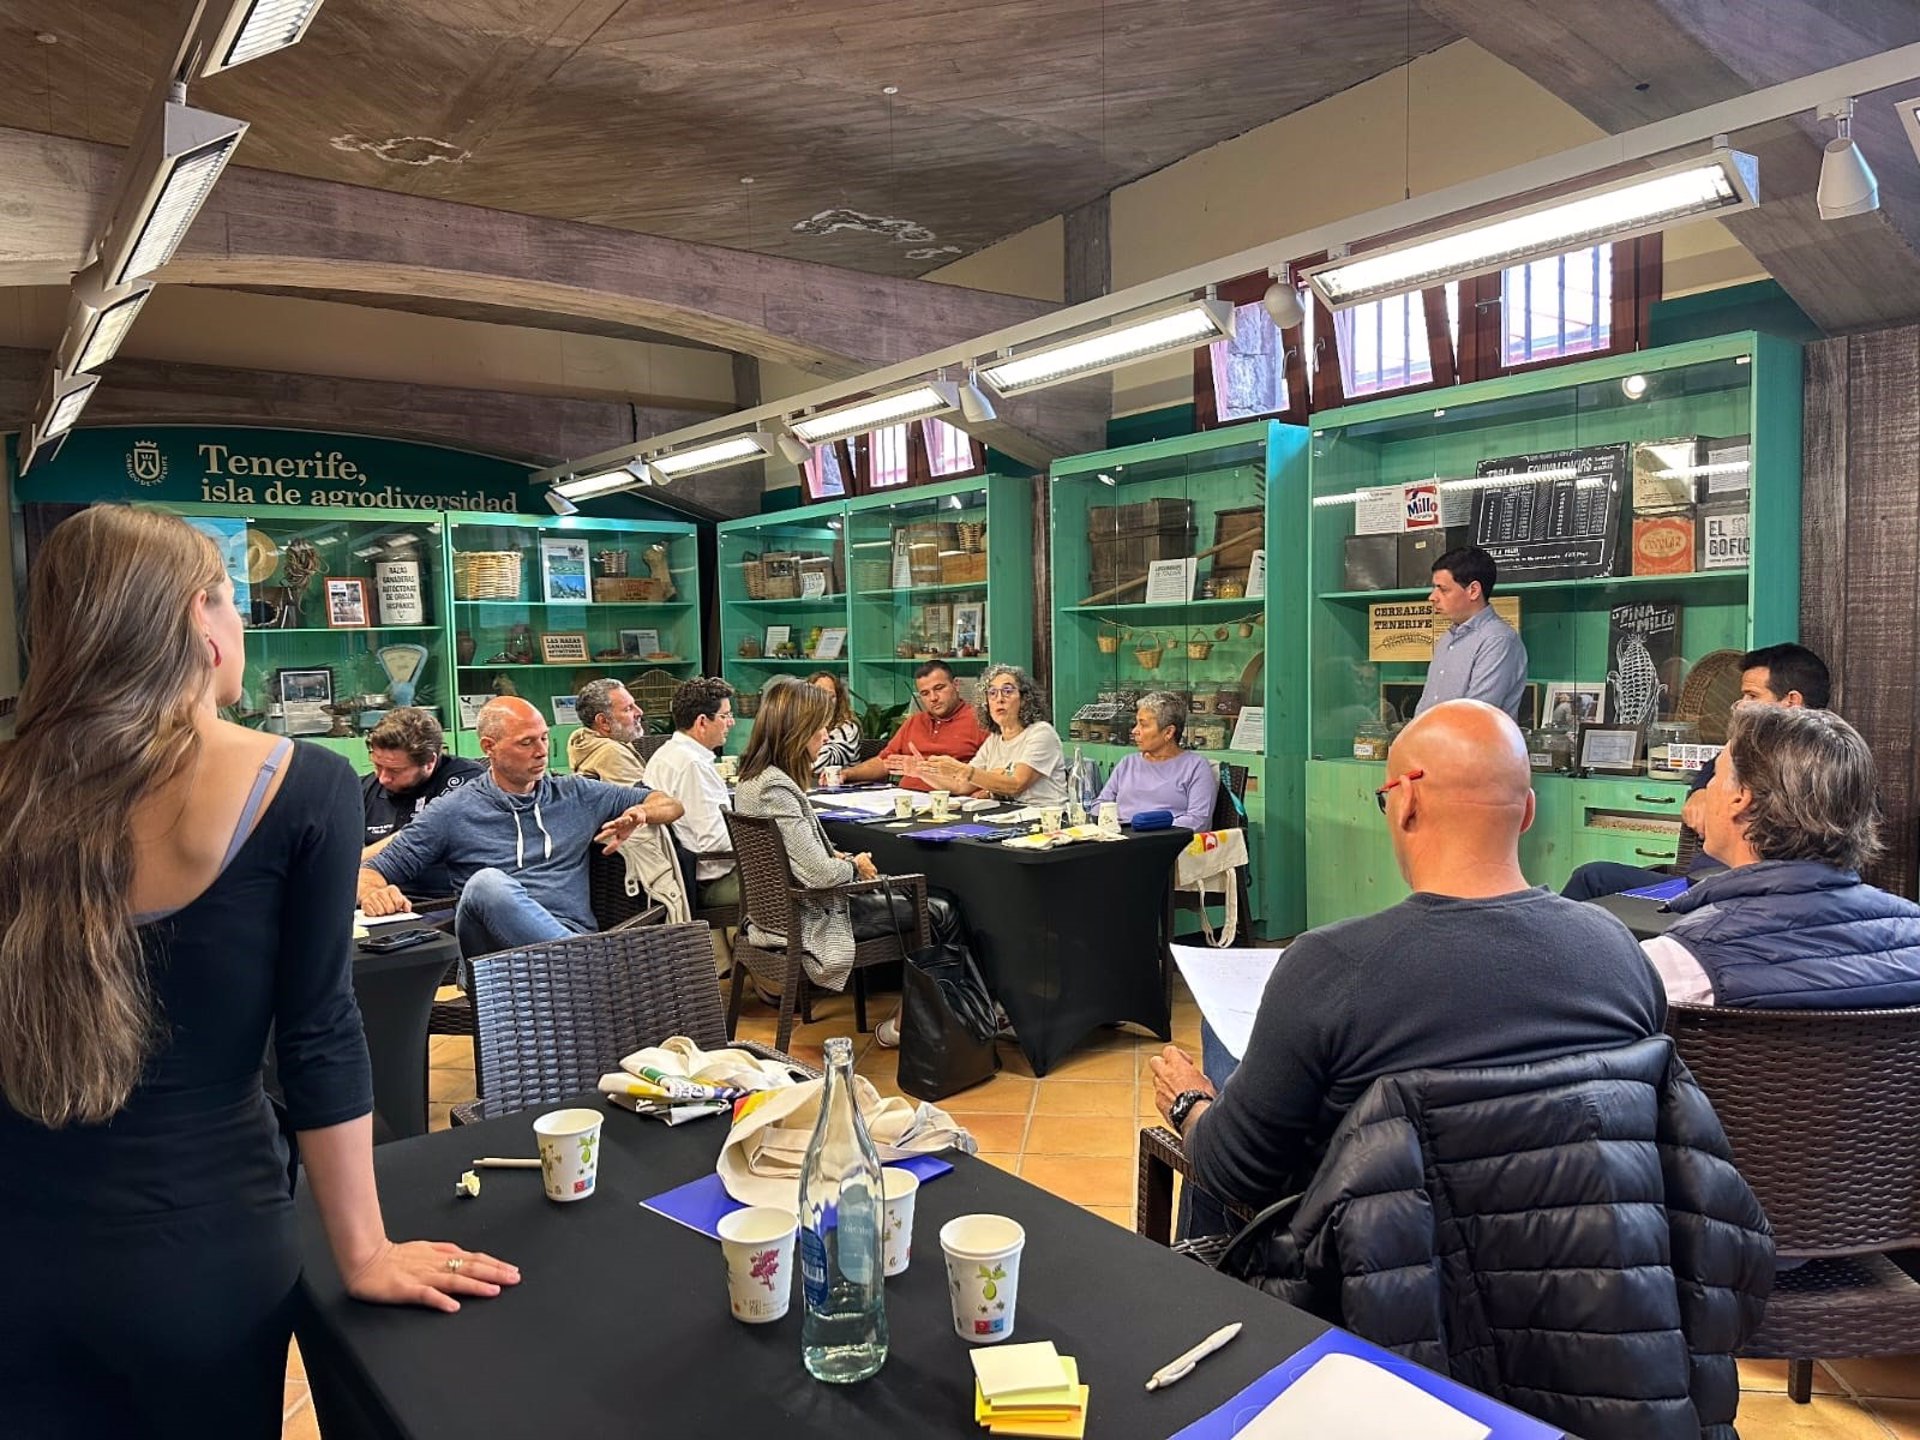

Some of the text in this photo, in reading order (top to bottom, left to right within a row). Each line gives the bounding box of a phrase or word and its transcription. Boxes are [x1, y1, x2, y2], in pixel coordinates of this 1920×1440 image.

[198, 443, 368, 487] Tenerife,
[201, 477, 519, 513] isla de agrodiversidad
[1407, 497, 1438, 517] Millo
[1709, 520, 1728, 537] EL
[1709, 537, 1751, 556] GOFIO
[1374, 605, 1433, 617] CEREALES
[1374, 619, 1432, 630] TENERIFE
